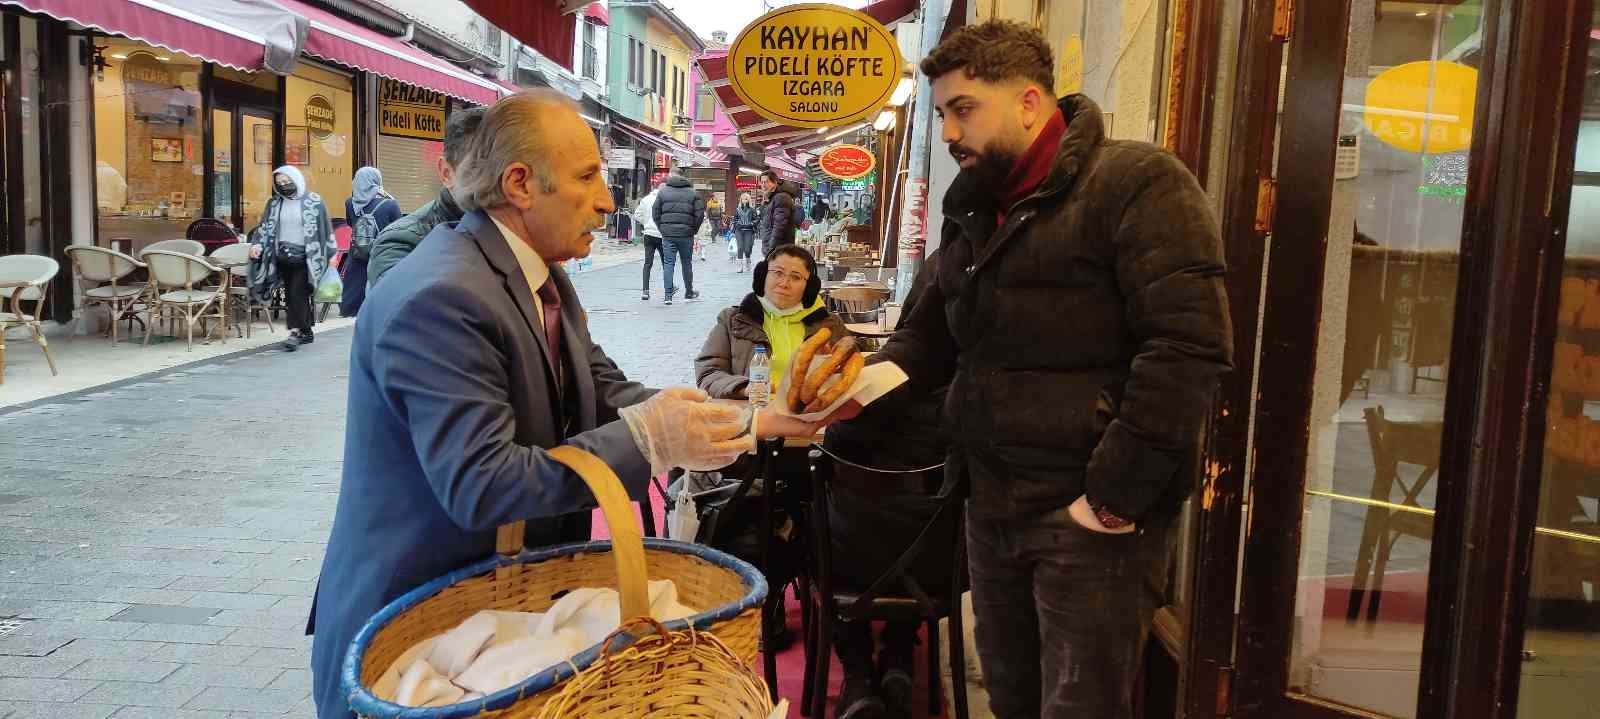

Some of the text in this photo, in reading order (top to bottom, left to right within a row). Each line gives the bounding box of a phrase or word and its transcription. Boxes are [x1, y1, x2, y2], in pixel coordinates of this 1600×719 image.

[760, 25, 868, 50] KAYHAN
[745, 54, 883, 76] PİDELİ KÖFTE
[783, 80, 845, 96] IZGARA
[790, 102, 838, 113] SALONU
[383, 109, 441, 132] Pideli Köfte
